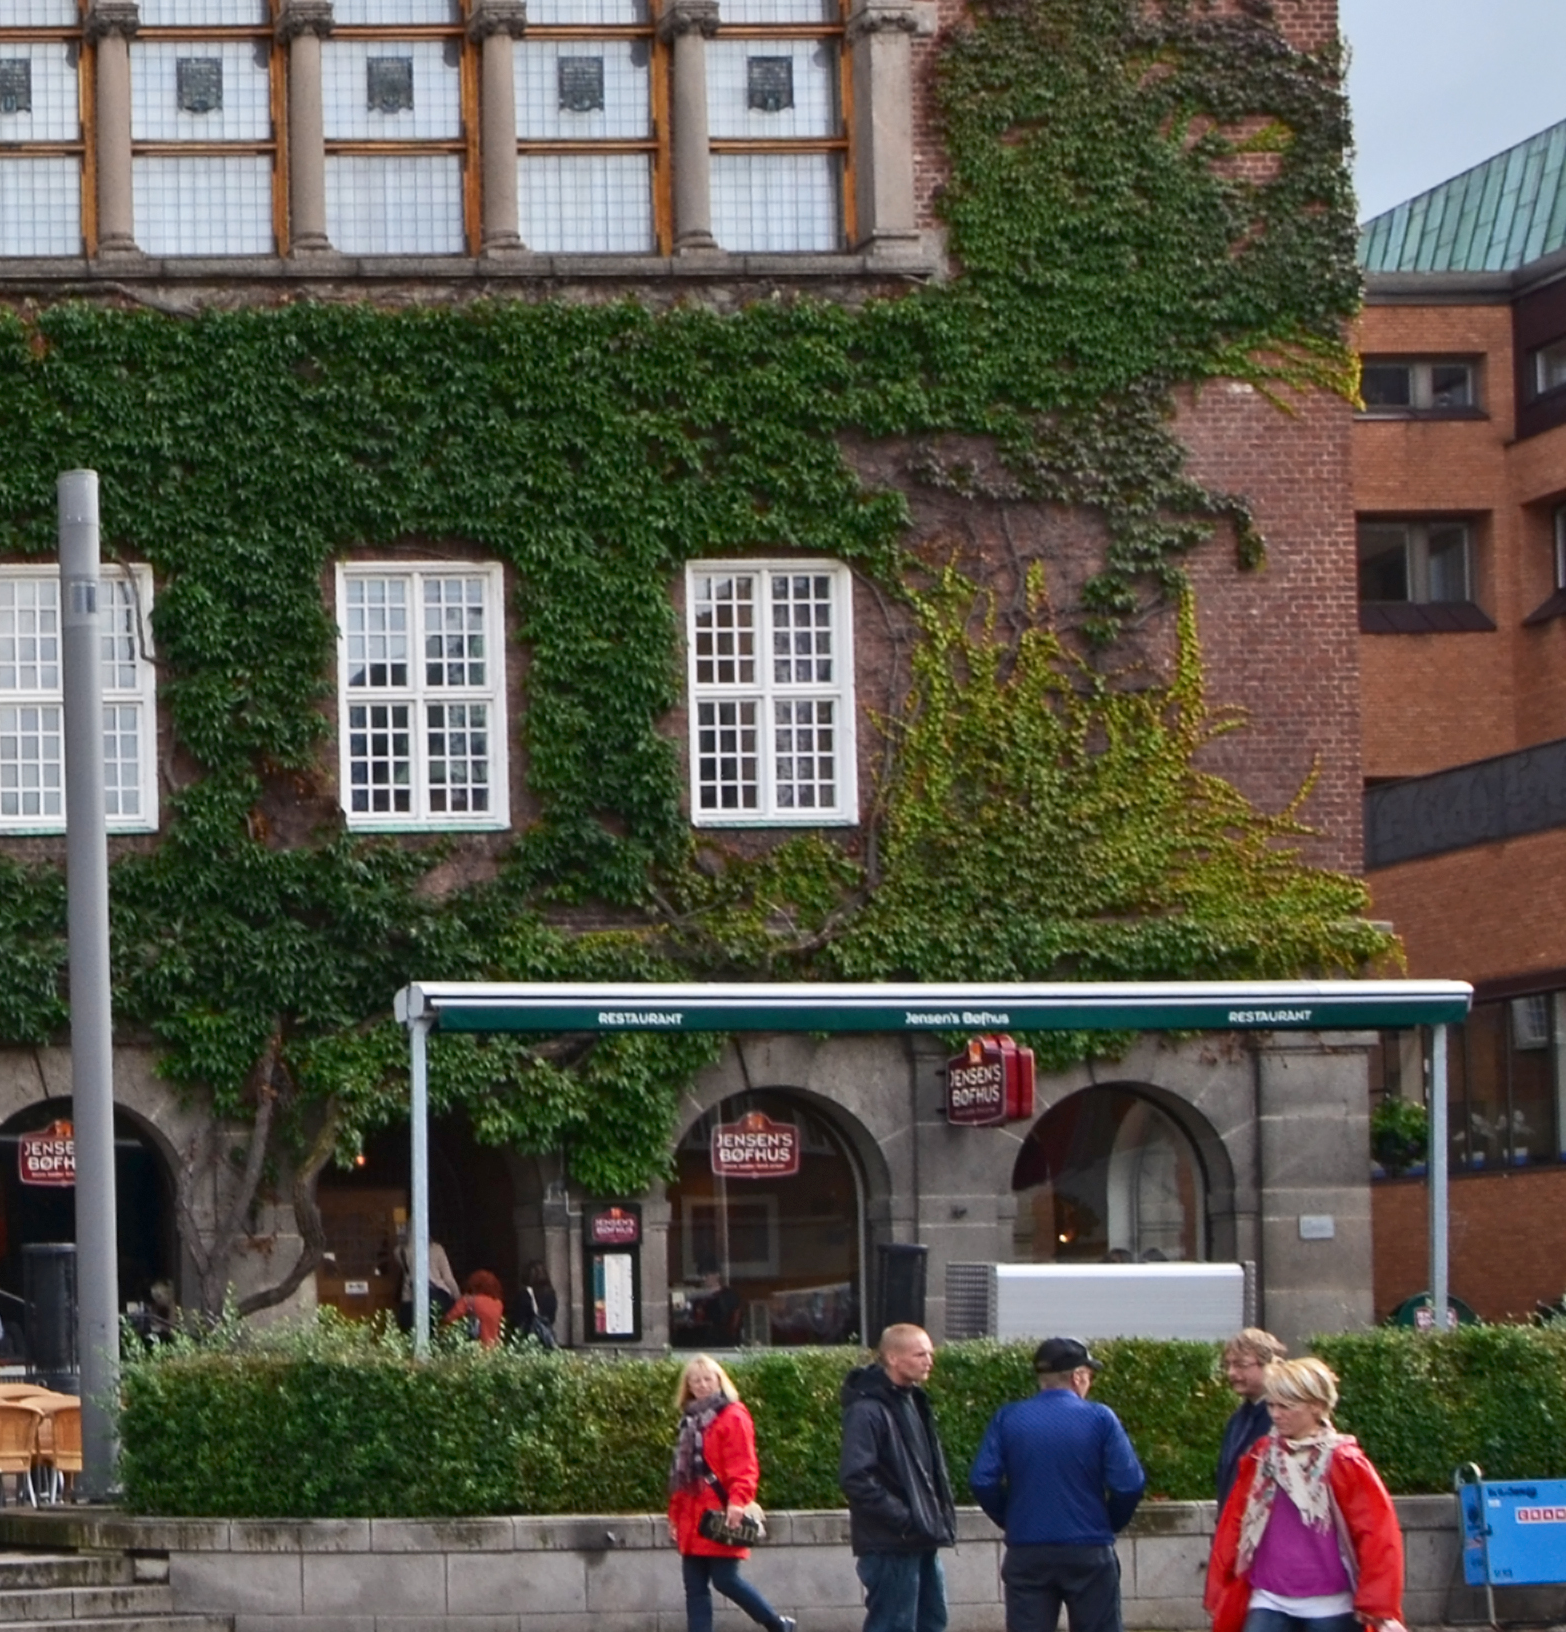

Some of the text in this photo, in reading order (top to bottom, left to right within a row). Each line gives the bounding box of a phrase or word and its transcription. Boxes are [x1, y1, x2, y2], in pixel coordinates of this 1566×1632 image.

[598, 1012, 683, 1025] RESTAURANT
[906, 1011, 960, 1025] Jensen's
[1229, 1010, 1312, 1023] RESTAURANT
[950, 1064, 1001, 1087] JENSEN'S
[717, 1133, 793, 1148] JENSEN'S
[24, 1141, 75, 1156] JENSE
[28, 1156, 76, 1171] BØFH
